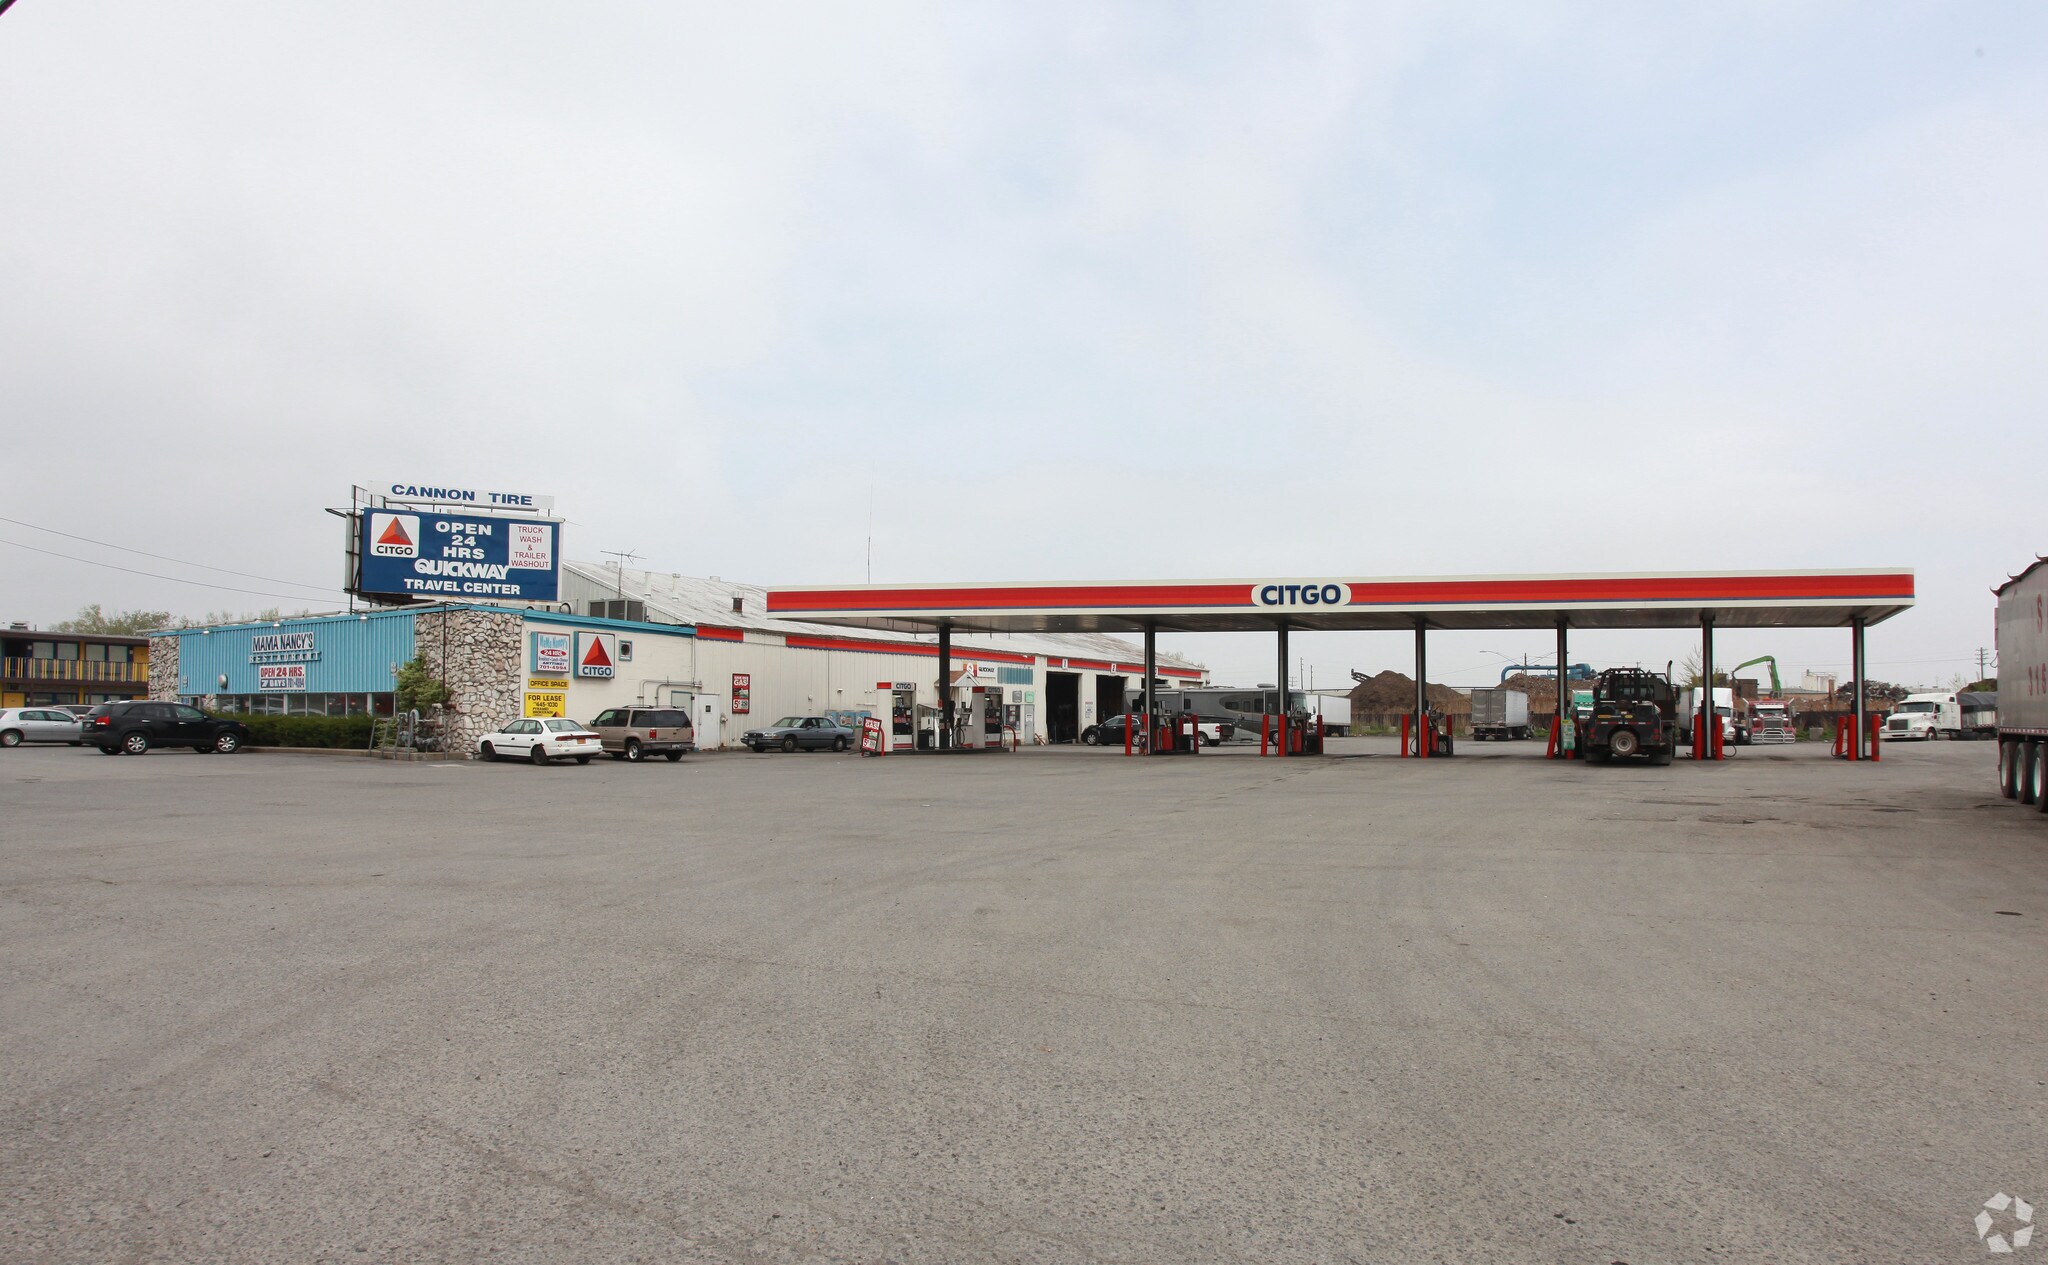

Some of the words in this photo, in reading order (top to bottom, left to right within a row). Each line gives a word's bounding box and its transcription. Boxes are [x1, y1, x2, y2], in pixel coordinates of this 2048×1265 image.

[391, 484, 475, 501] CANNON
[488, 492, 533, 506] TIRE
[435, 521, 492, 536] OPEN
[517, 526, 544, 534] TRUCK
[451, 535, 476, 547] 24
[376, 545, 414, 556] CITGO
[443, 547, 485, 560] HRS
[514, 551, 547, 559] TRAILER
[414, 558, 510, 580] QUICKWAY
[511, 560, 549, 568] WASHOUT
[404, 578, 461, 592] TRAVEL
[463, 582, 521, 595] CENTER
[1260, 584, 1341, 605] CITGO
[252, 637, 279, 651] MAMA
[280, 633, 313, 650] NANCY'S
[249, 653, 319, 662] RESTAURANT
[261, 667, 276, 677] OPEN
[276, 667, 287, 677] 24
[289, 666, 305, 677] HRS.
[582, 666, 612, 676] CITGO
[261, 680, 269, 688] 7
[269, 679, 286, 687] DAYS
